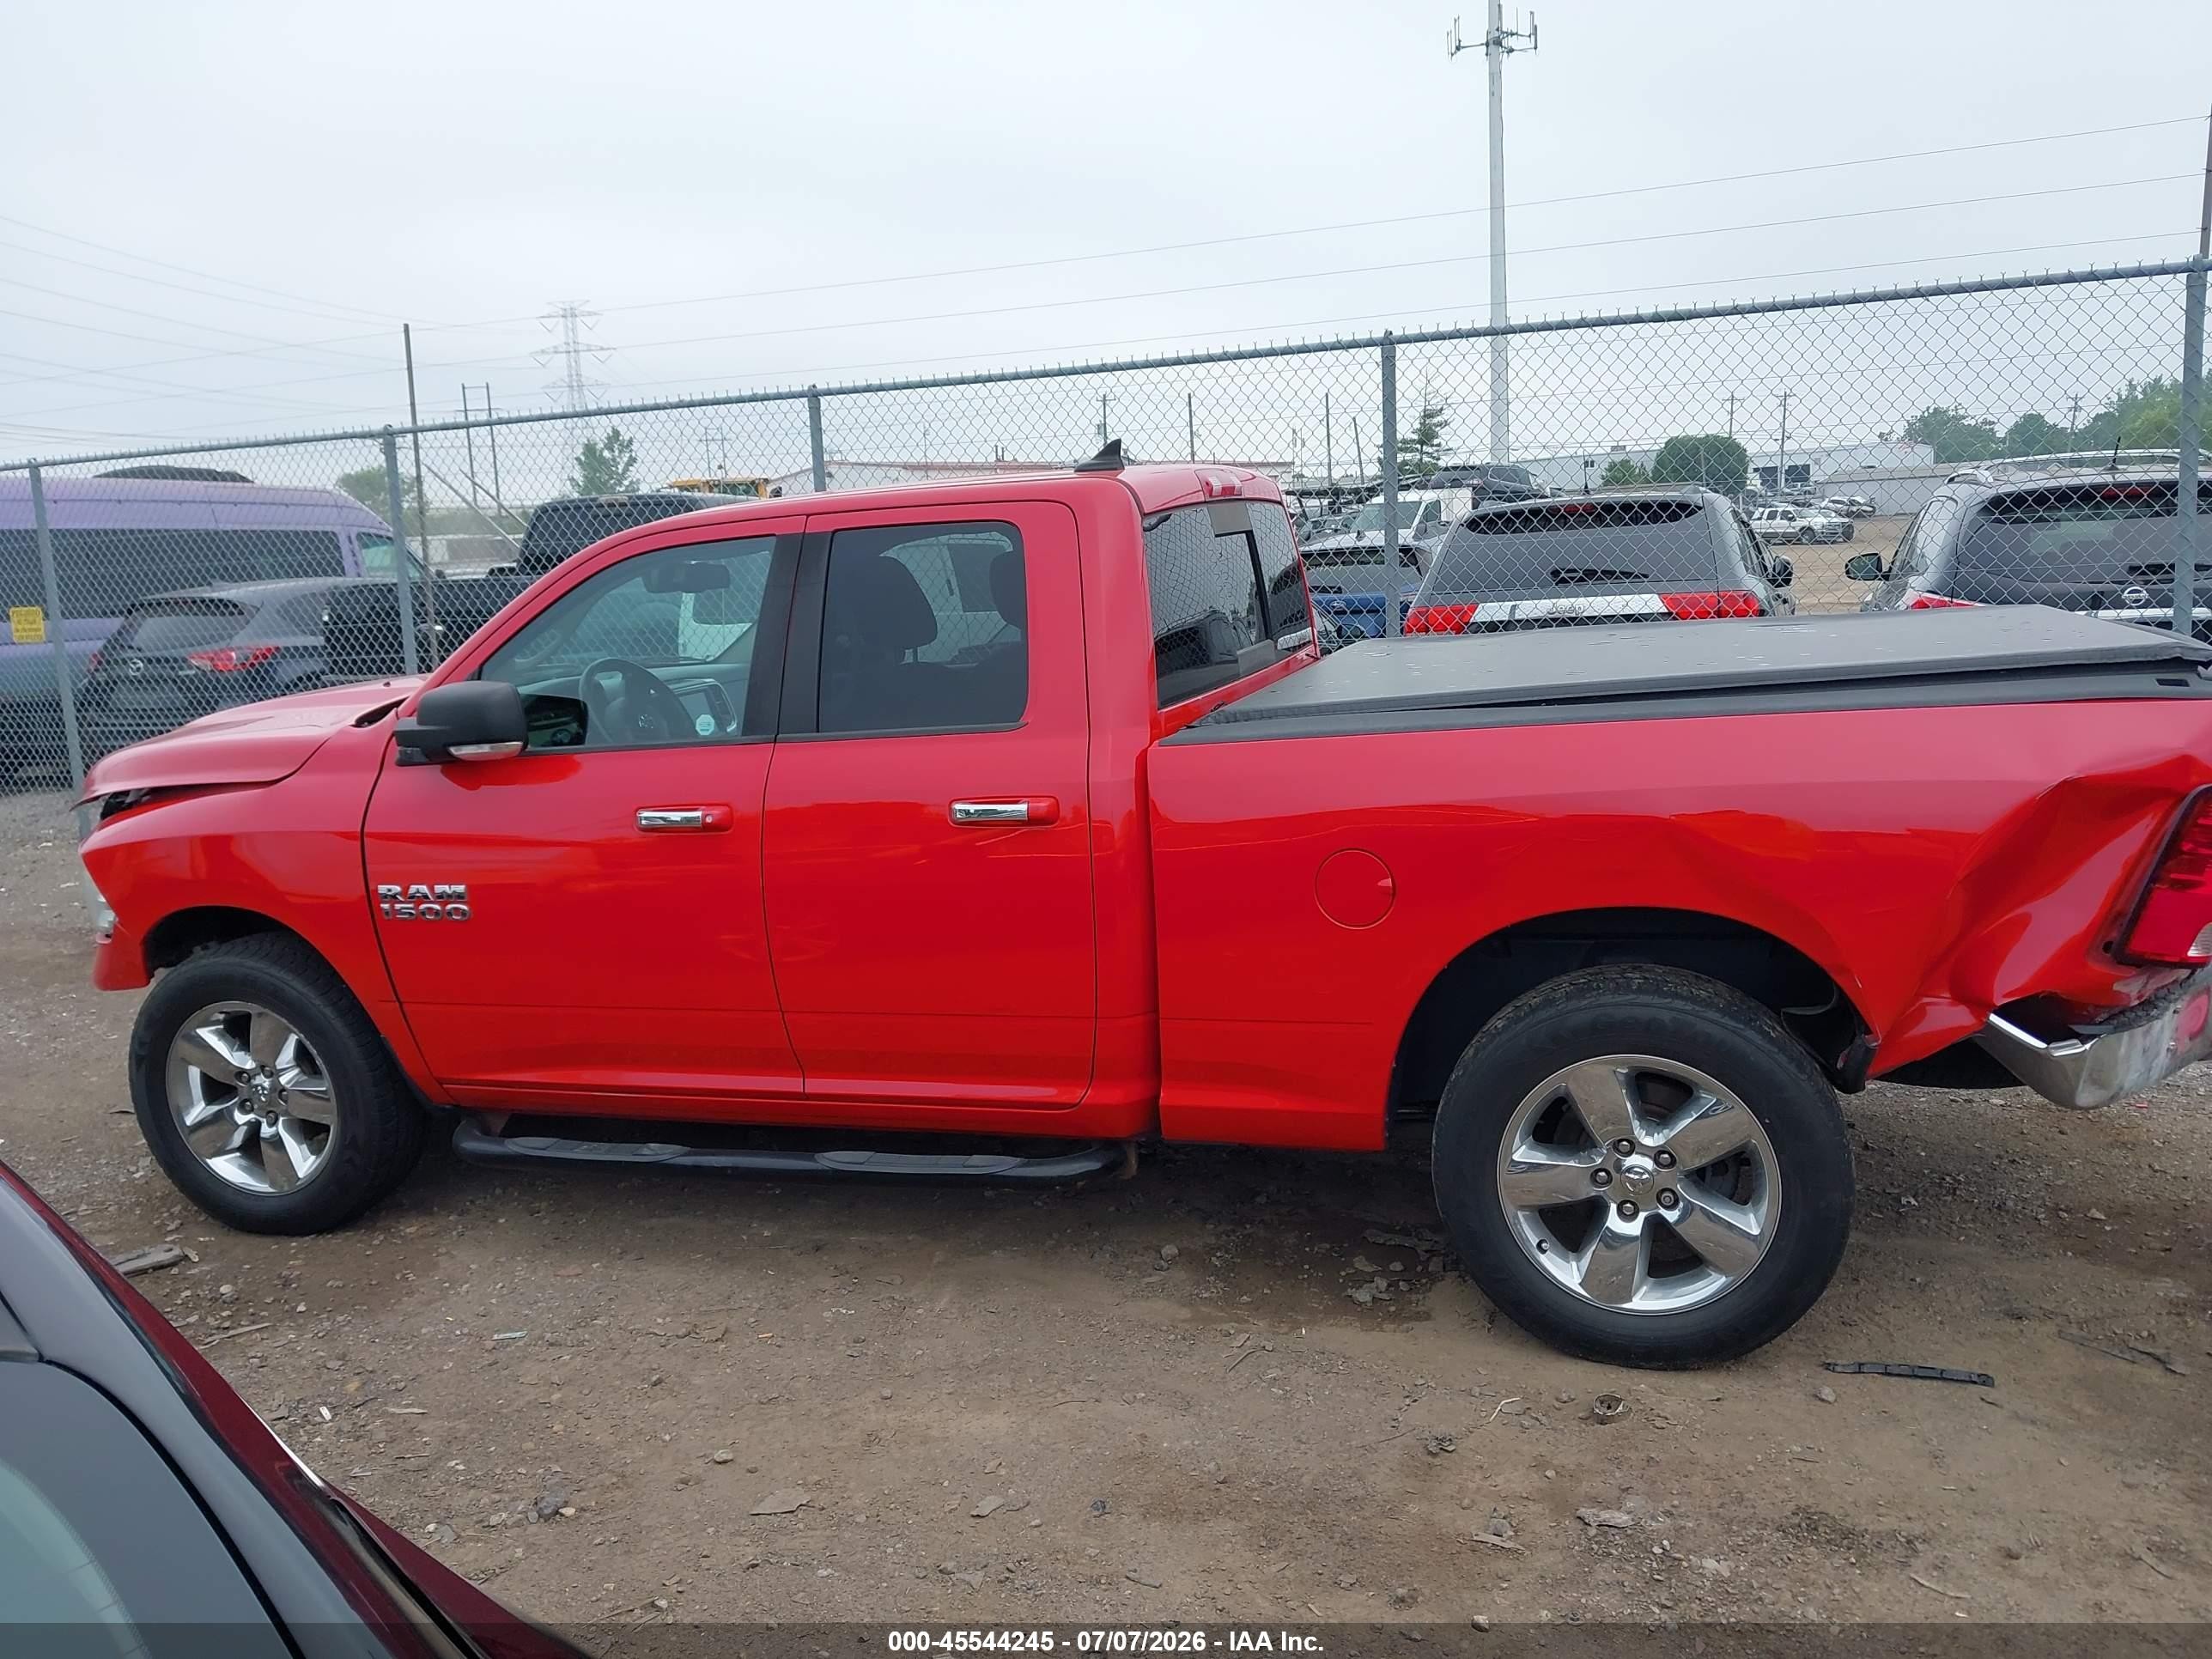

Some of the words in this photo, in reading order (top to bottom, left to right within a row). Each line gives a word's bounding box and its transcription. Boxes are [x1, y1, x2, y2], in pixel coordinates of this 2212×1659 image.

[1547, 603, 1584, 616] Jeep
[378, 884, 467, 901] RAM
[380, 903, 471, 921] 1500
